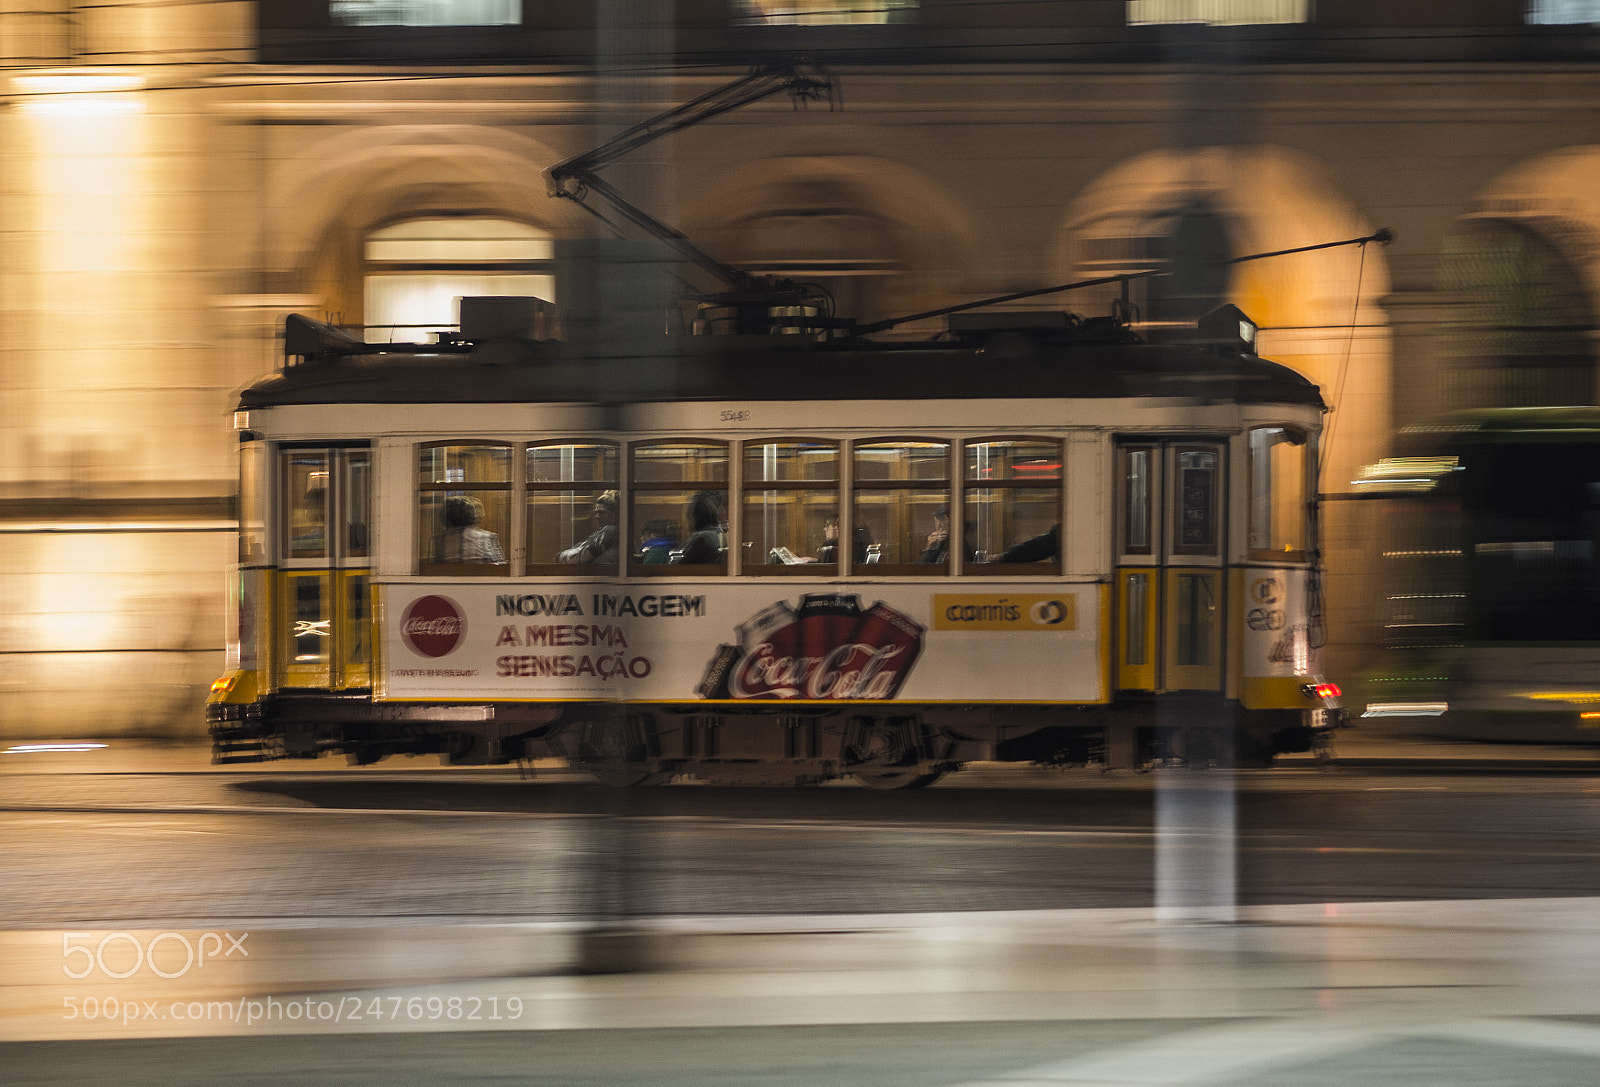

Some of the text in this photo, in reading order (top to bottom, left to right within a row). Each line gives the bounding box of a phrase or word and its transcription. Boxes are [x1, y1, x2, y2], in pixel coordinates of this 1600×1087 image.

[495, 594, 706, 617] NOVA IMAGEM
[525, 624, 628, 648] MESMA
[495, 651, 652, 681] SENSAÇÃO
